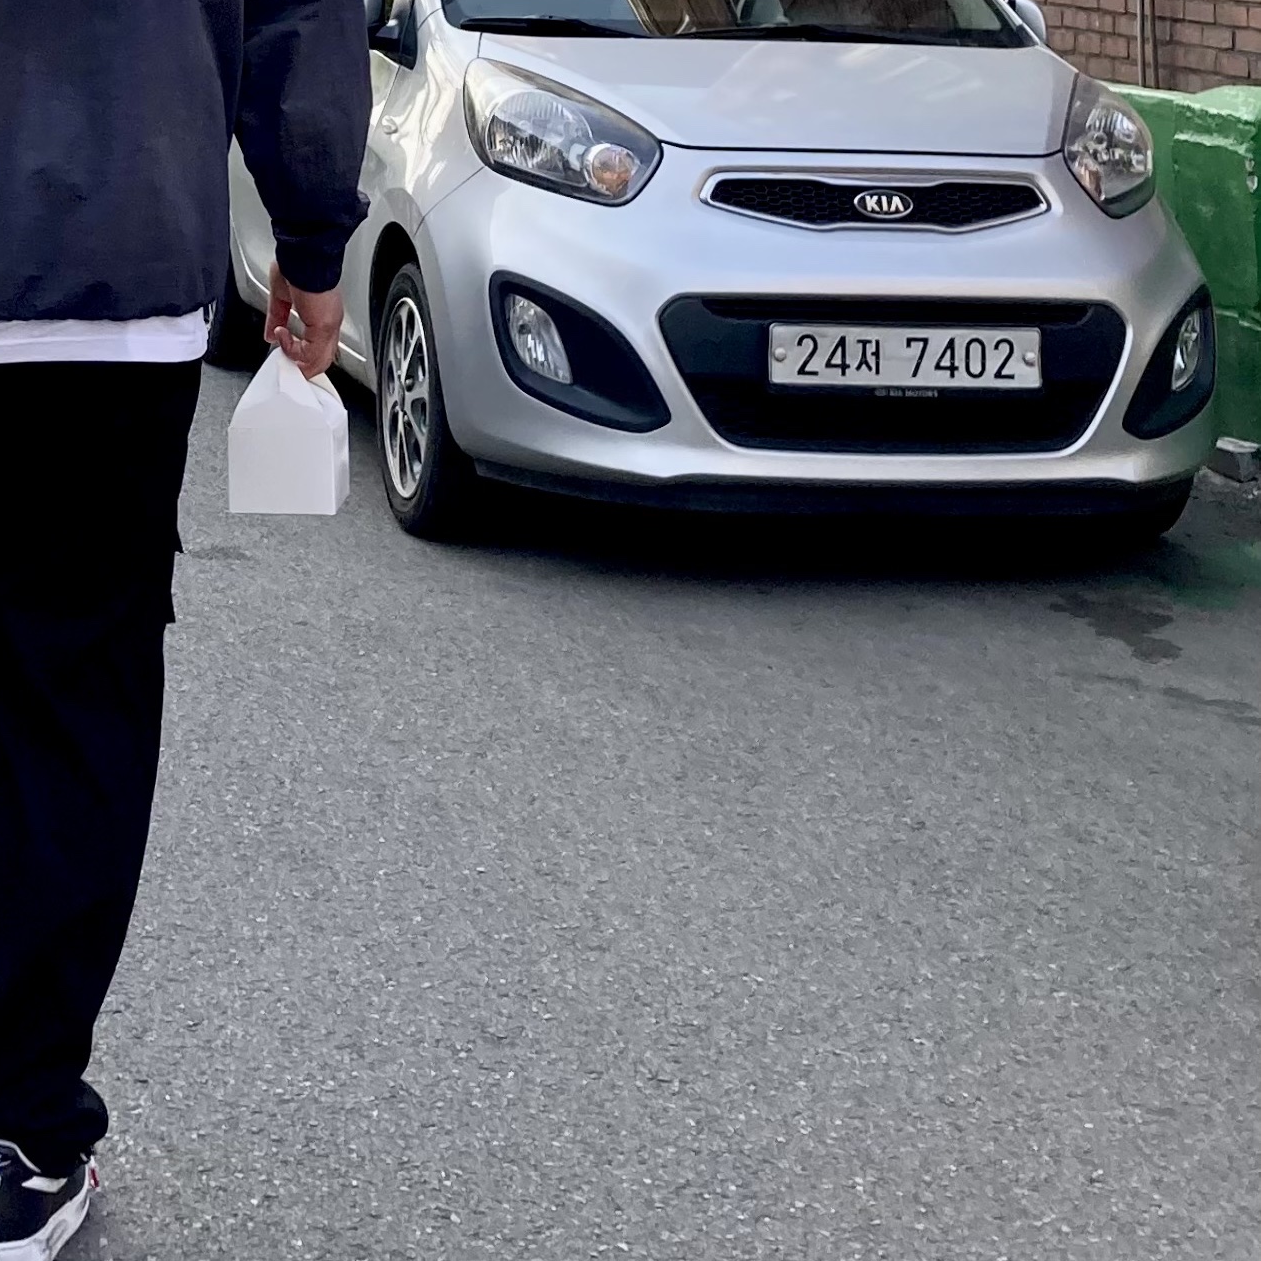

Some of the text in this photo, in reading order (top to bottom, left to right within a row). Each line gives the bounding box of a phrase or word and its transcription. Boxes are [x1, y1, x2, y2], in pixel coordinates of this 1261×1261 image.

[864, 194, 905, 213] KIA
[795, 333, 1016, 380] 24저 7402
